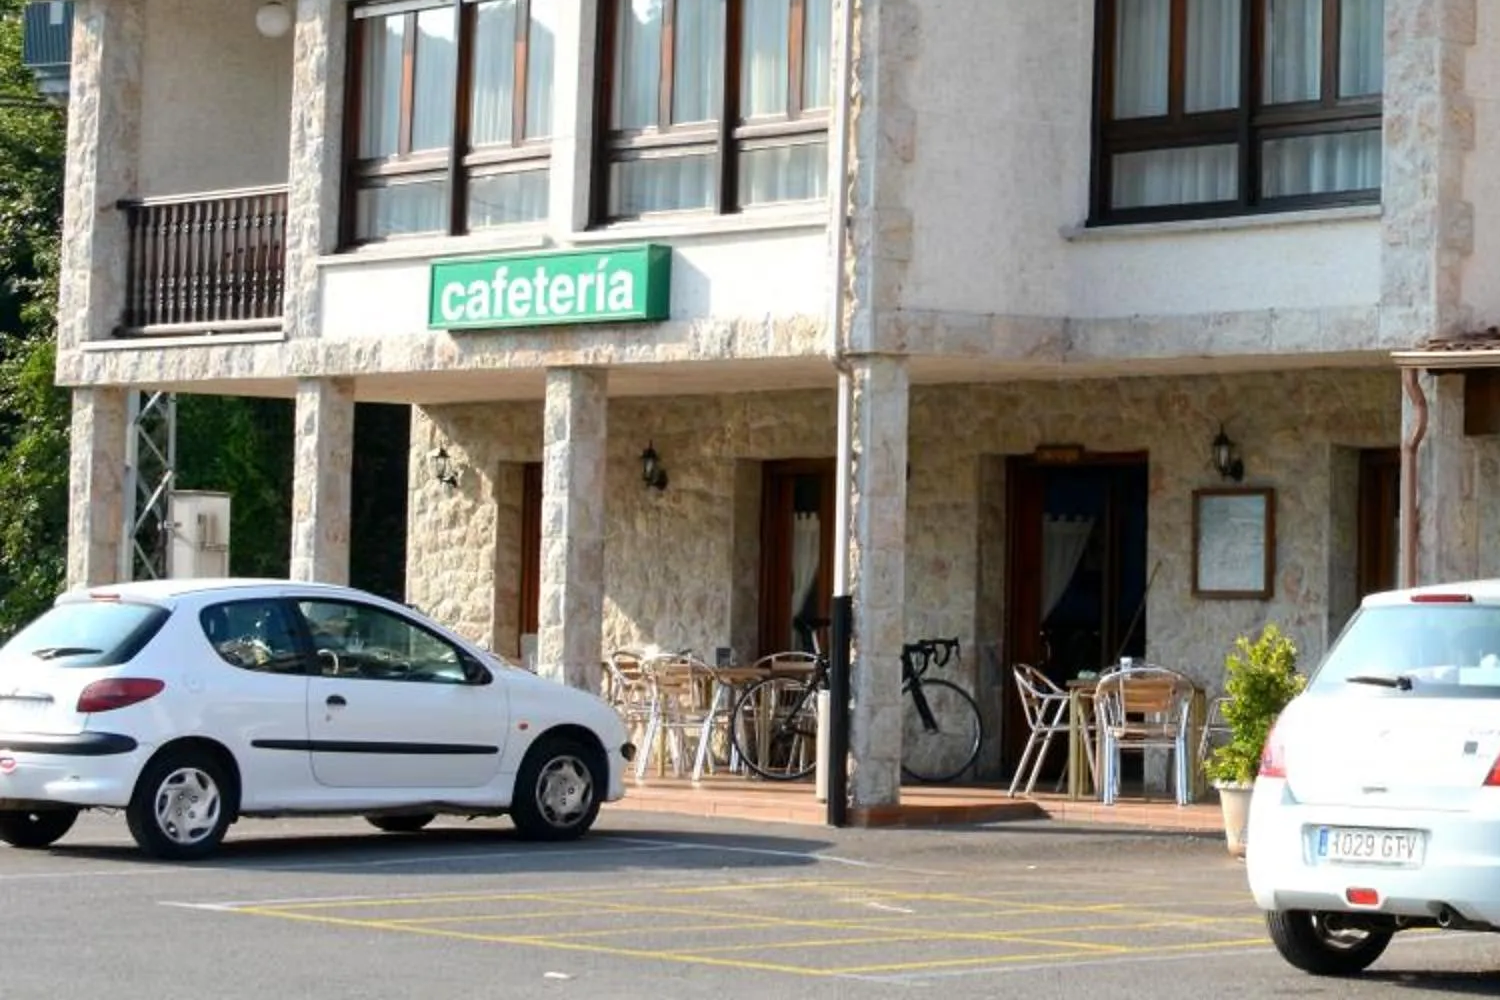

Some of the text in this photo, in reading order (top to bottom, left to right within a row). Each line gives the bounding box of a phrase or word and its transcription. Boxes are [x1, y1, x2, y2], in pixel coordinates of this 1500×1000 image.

[440, 258, 634, 321] cafetería
[1332, 832, 1417, 859] 1029 GTV
